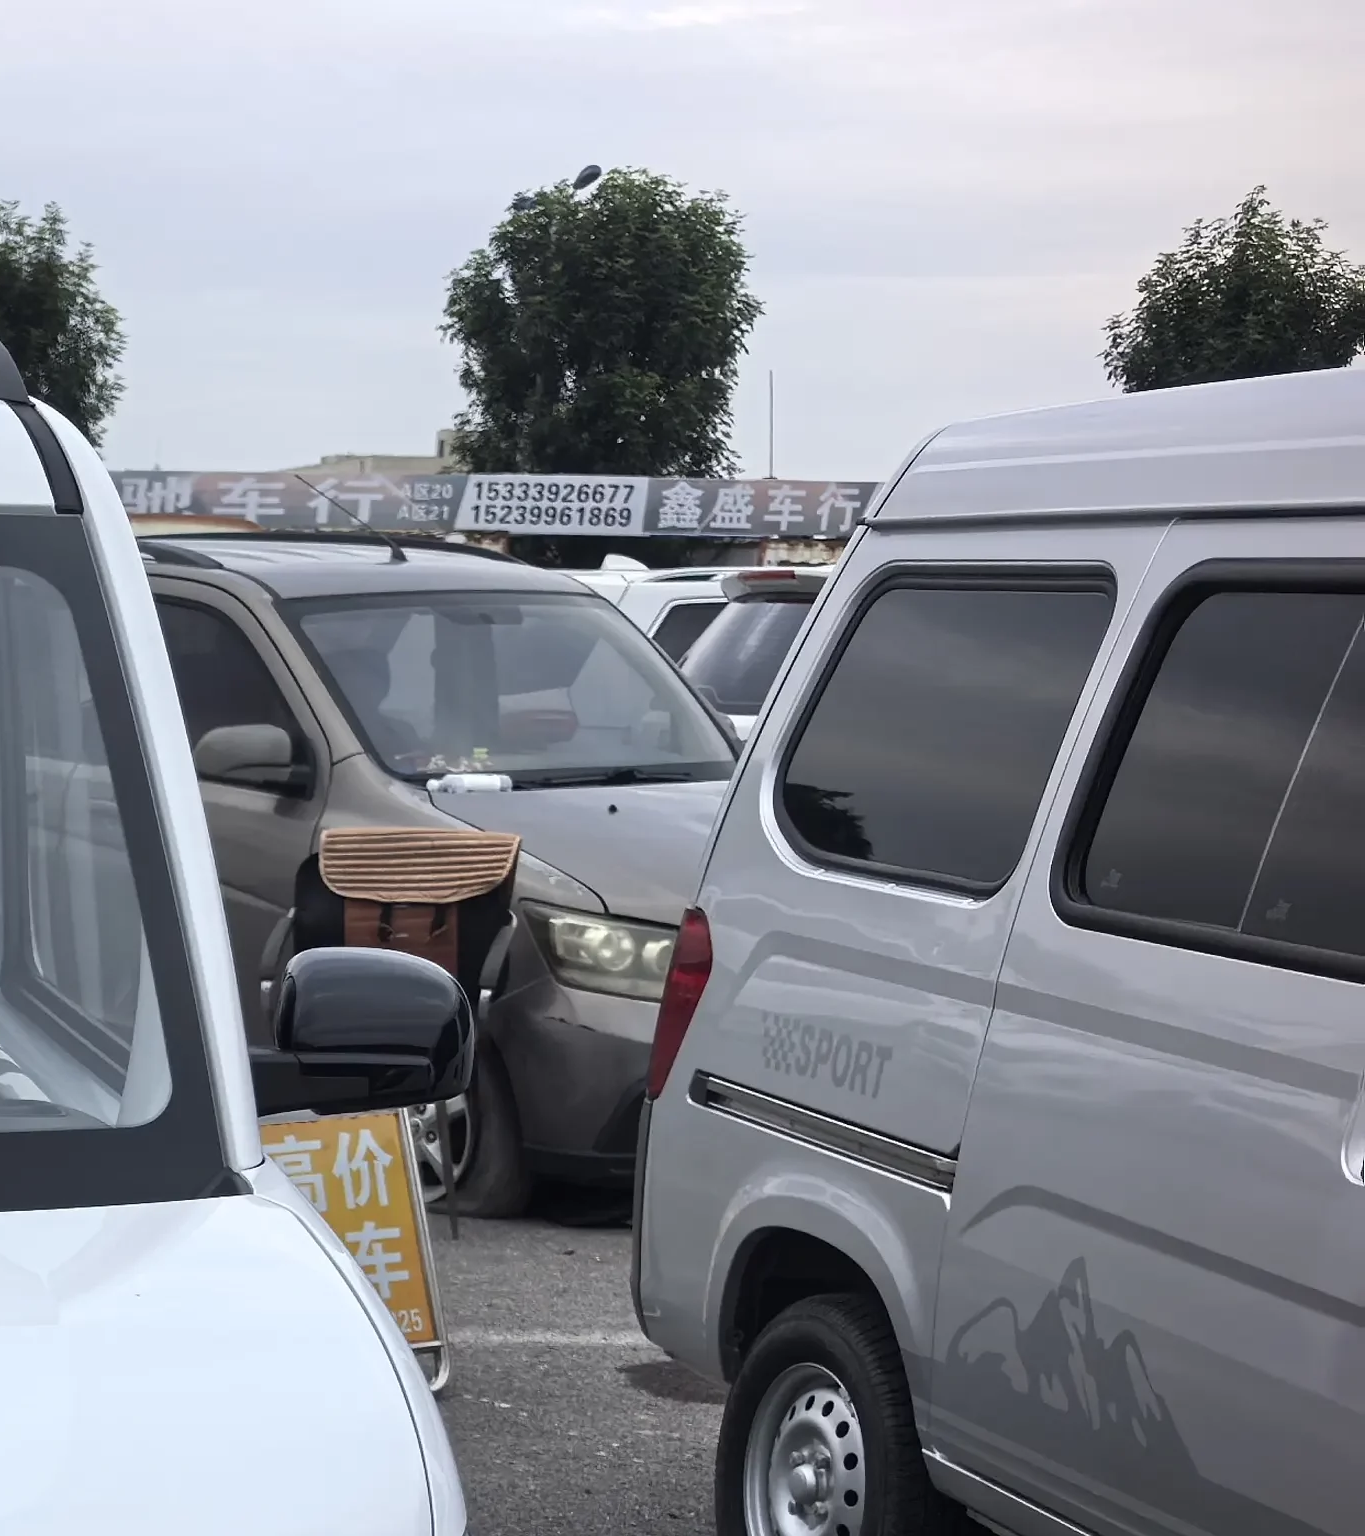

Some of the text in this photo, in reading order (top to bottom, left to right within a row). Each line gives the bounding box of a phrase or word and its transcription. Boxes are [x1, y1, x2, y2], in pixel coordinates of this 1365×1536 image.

[401, 483, 454, 500] A区20
[473, 481, 636, 505] 15333926677
[397, 504, 450, 522] A区21
[470, 504, 633, 528] 15239961869
[657, 480, 862, 533] 鑫盛车行
[794, 1023, 893, 1100] SPORT
[261, 1128, 393, 1213] 高价
